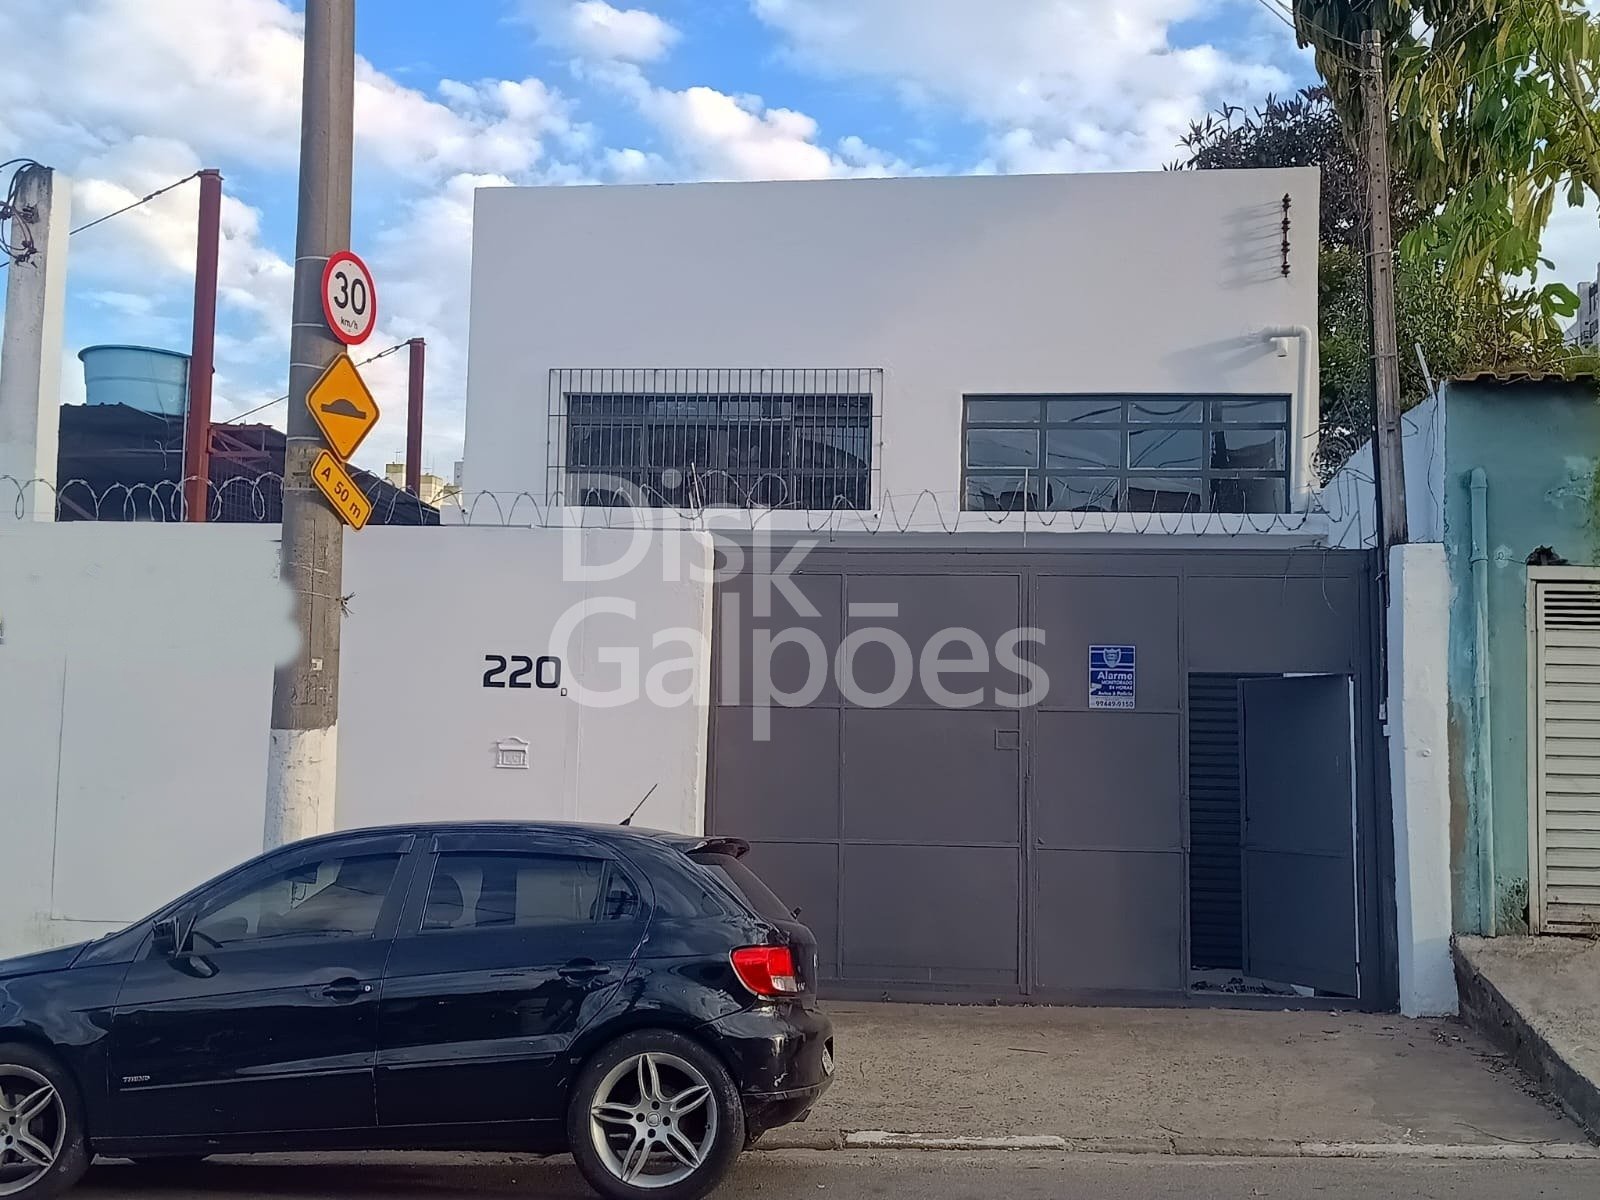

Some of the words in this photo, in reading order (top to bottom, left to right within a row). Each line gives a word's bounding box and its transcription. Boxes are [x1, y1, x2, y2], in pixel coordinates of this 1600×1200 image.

[334, 271, 366, 315] 30
[340, 316, 358, 330] km/h
[321, 467, 331, 482] A
[334, 481, 349, 502] 50
[349, 502, 361, 519] m
[483, 655, 561, 688] 220
